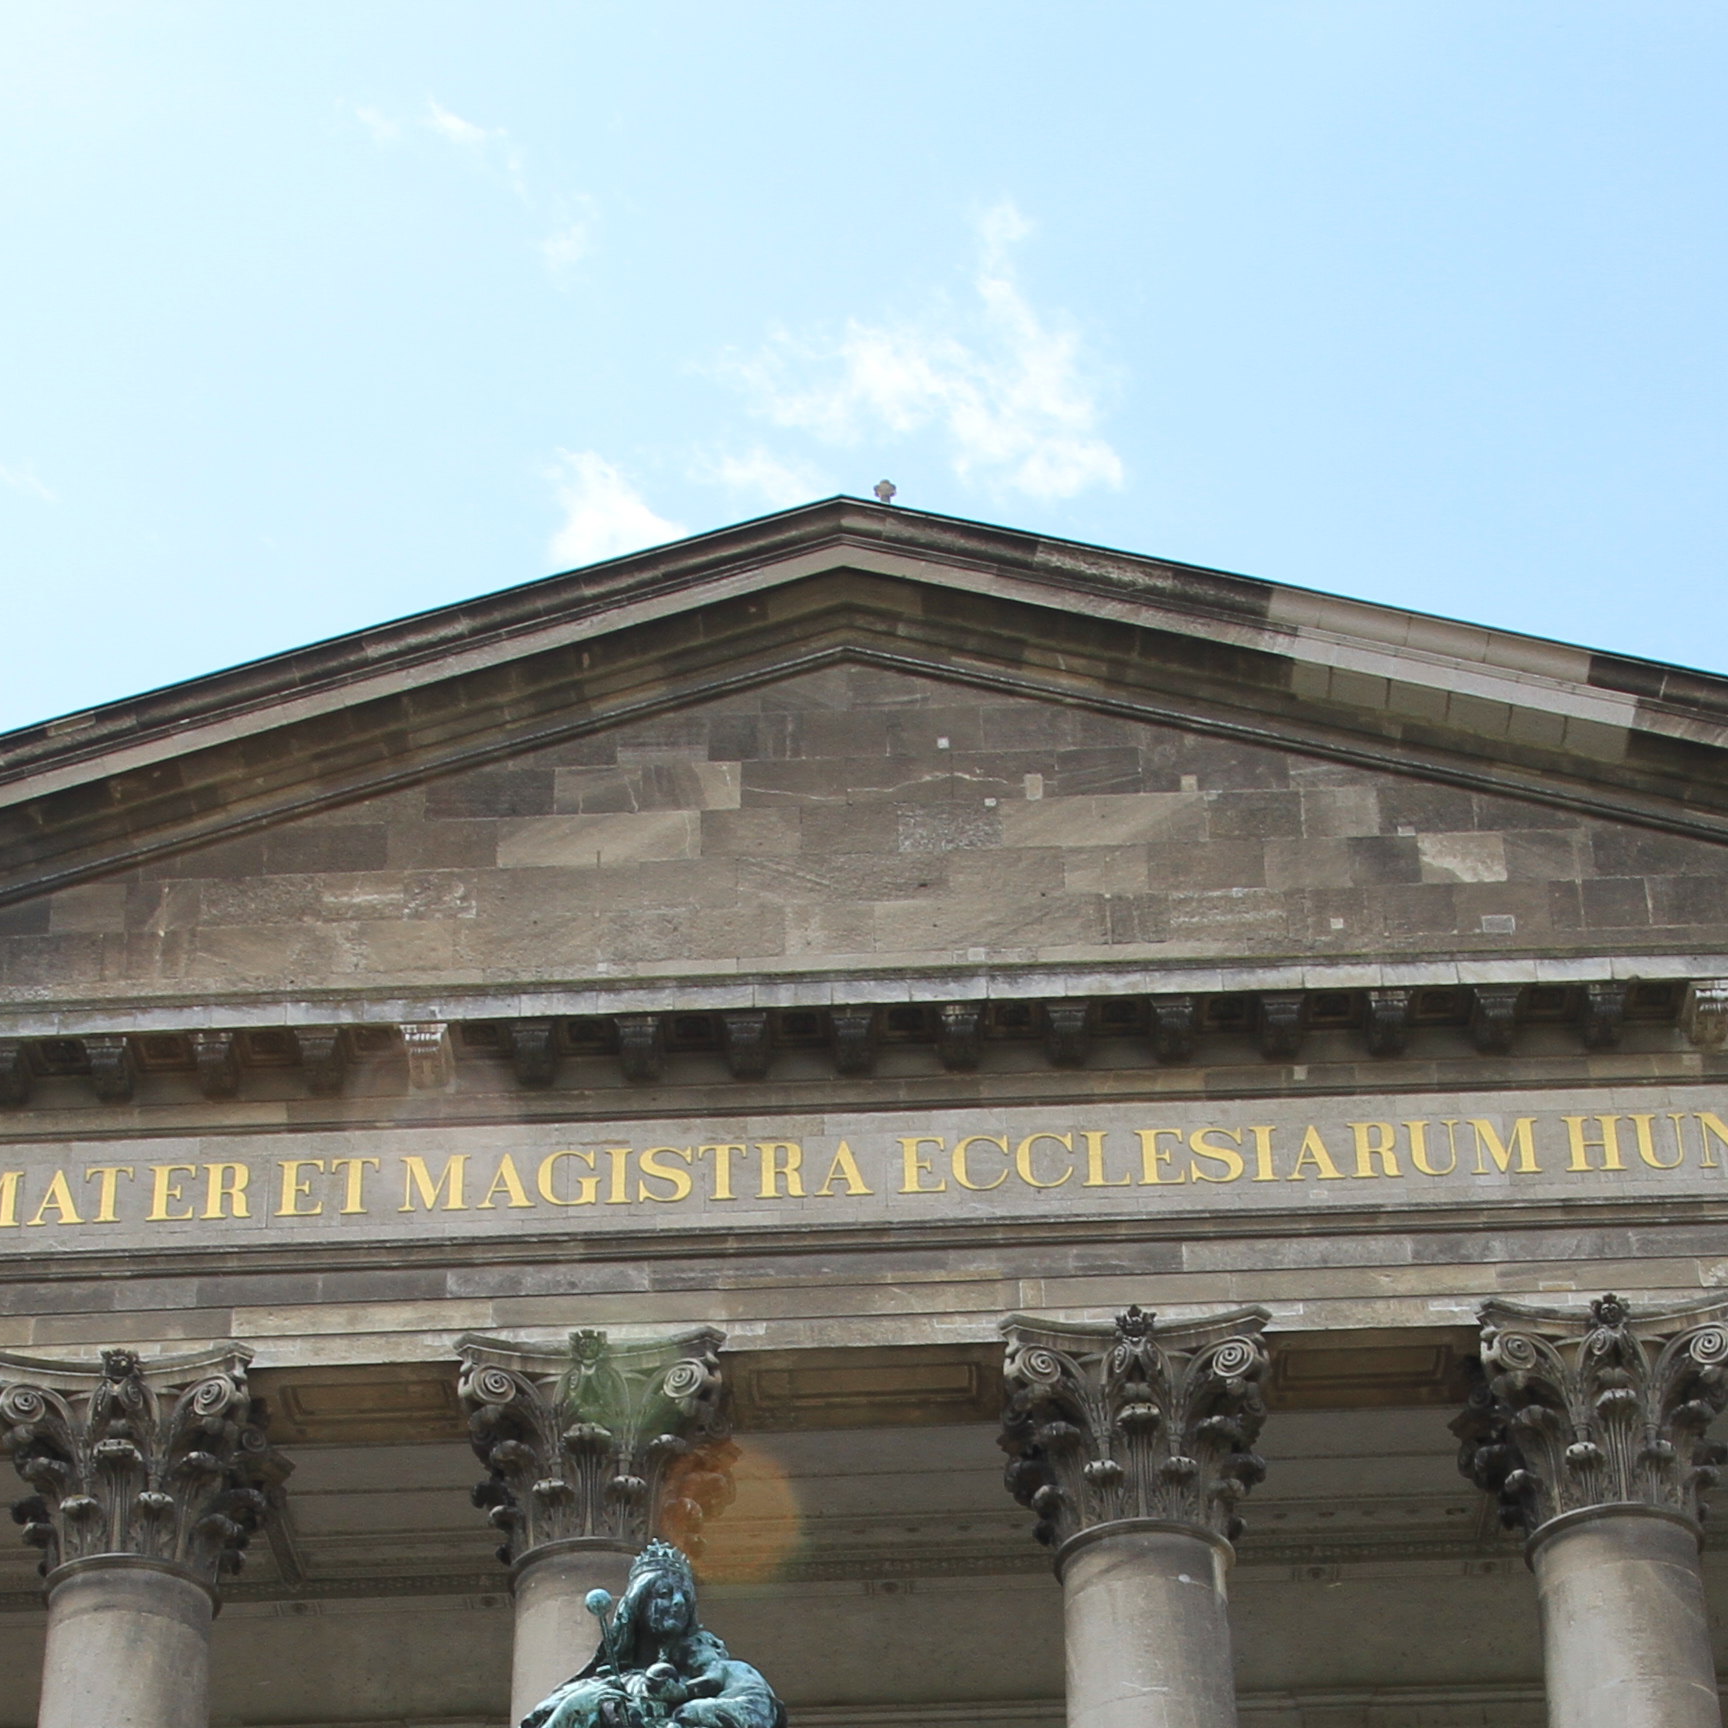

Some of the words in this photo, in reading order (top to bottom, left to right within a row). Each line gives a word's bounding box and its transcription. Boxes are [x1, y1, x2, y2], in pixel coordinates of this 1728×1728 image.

[274, 1157, 381, 1217] ET
[397, 1140, 875, 1214] MAGISTRA
[896, 1115, 1546, 1194] ECCLESIARUM
